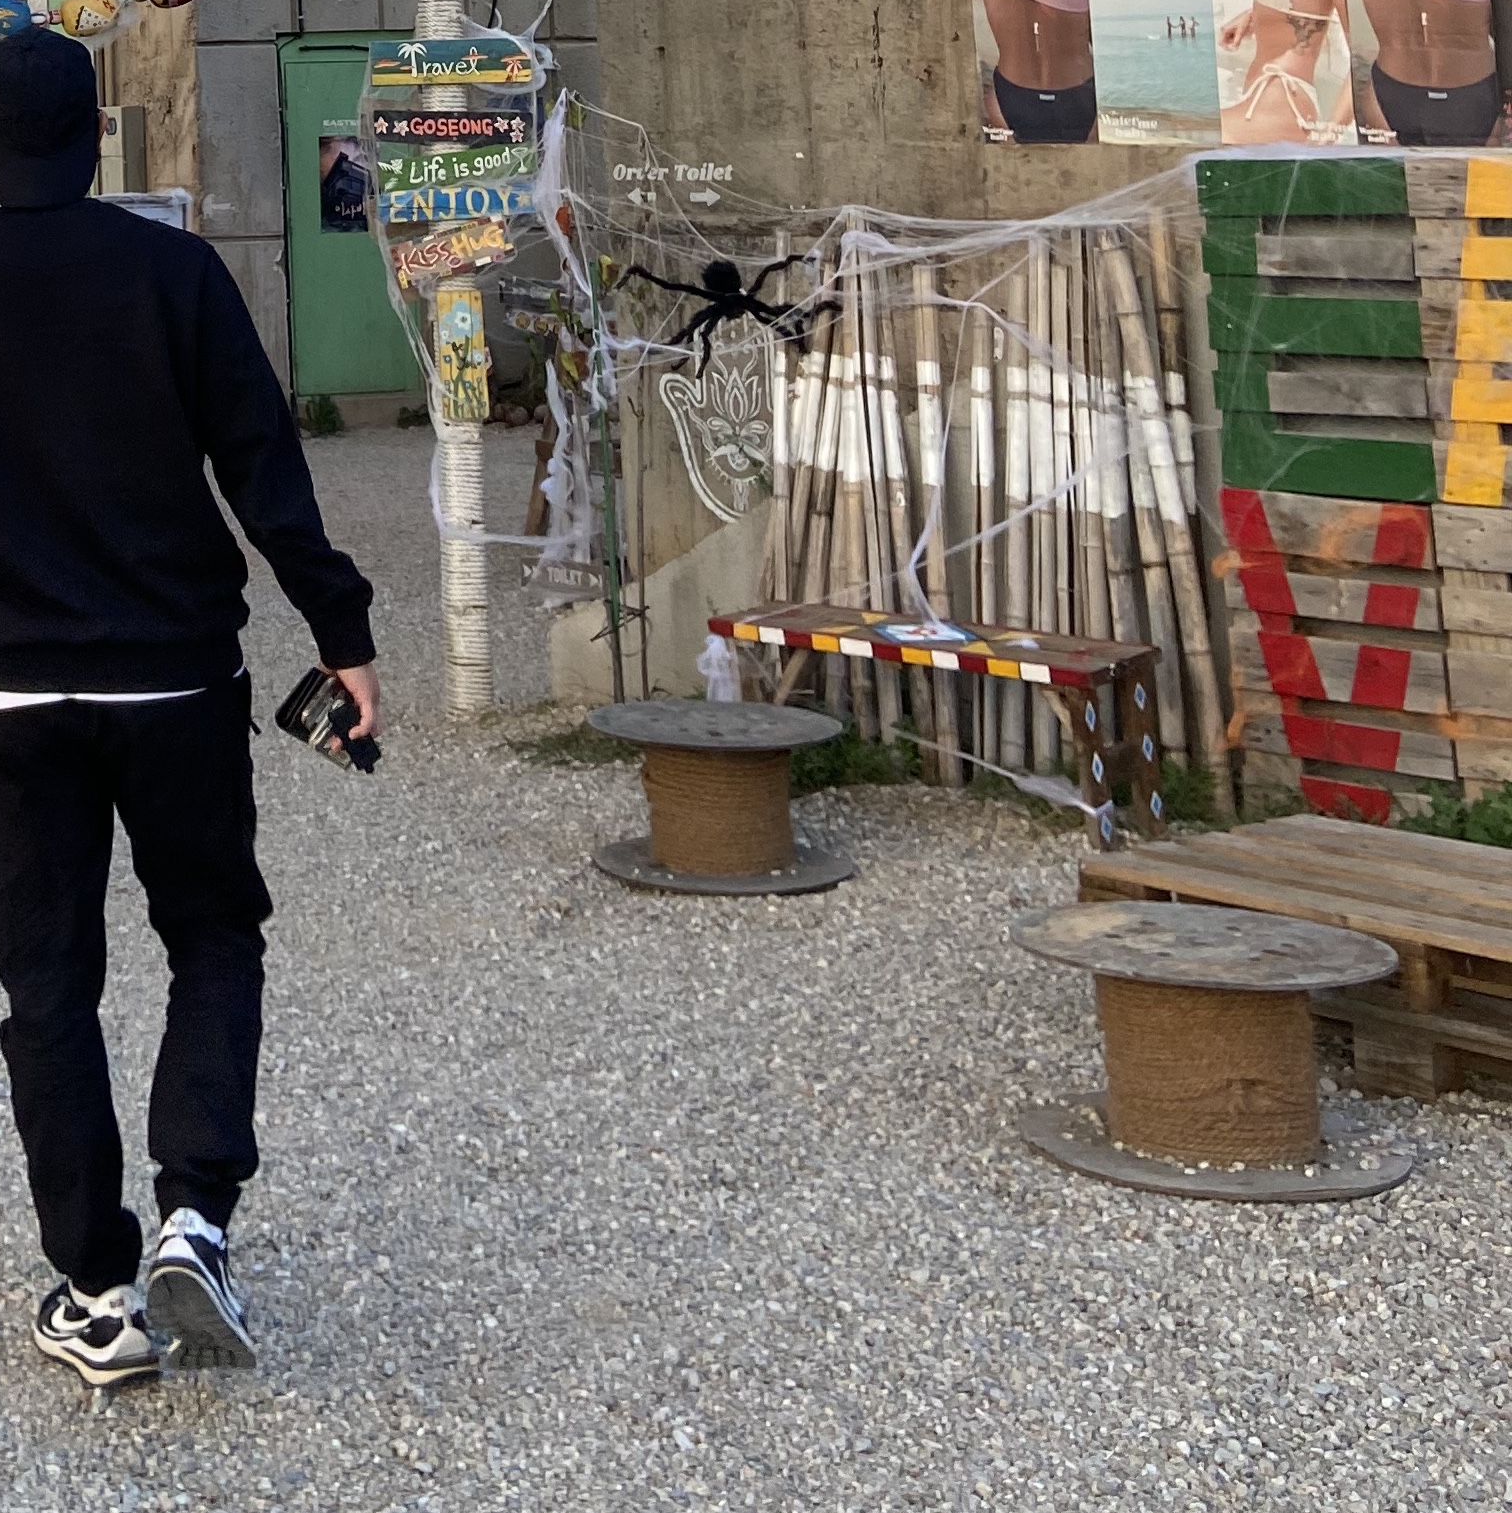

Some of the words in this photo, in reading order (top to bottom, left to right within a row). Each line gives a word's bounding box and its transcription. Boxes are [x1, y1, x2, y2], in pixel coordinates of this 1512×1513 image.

[397, 42, 481, 78] Travel
[409, 117, 494, 137] GOSEONG
[408, 155, 447, 184] Life
[451, 157, 471, 178] is
[472, 146, 511, 176] good
[674, 162, 734, 181] Toilet
[389, 186, 514, 224] ENJOY
[400, 240, 449, 276] KISS
